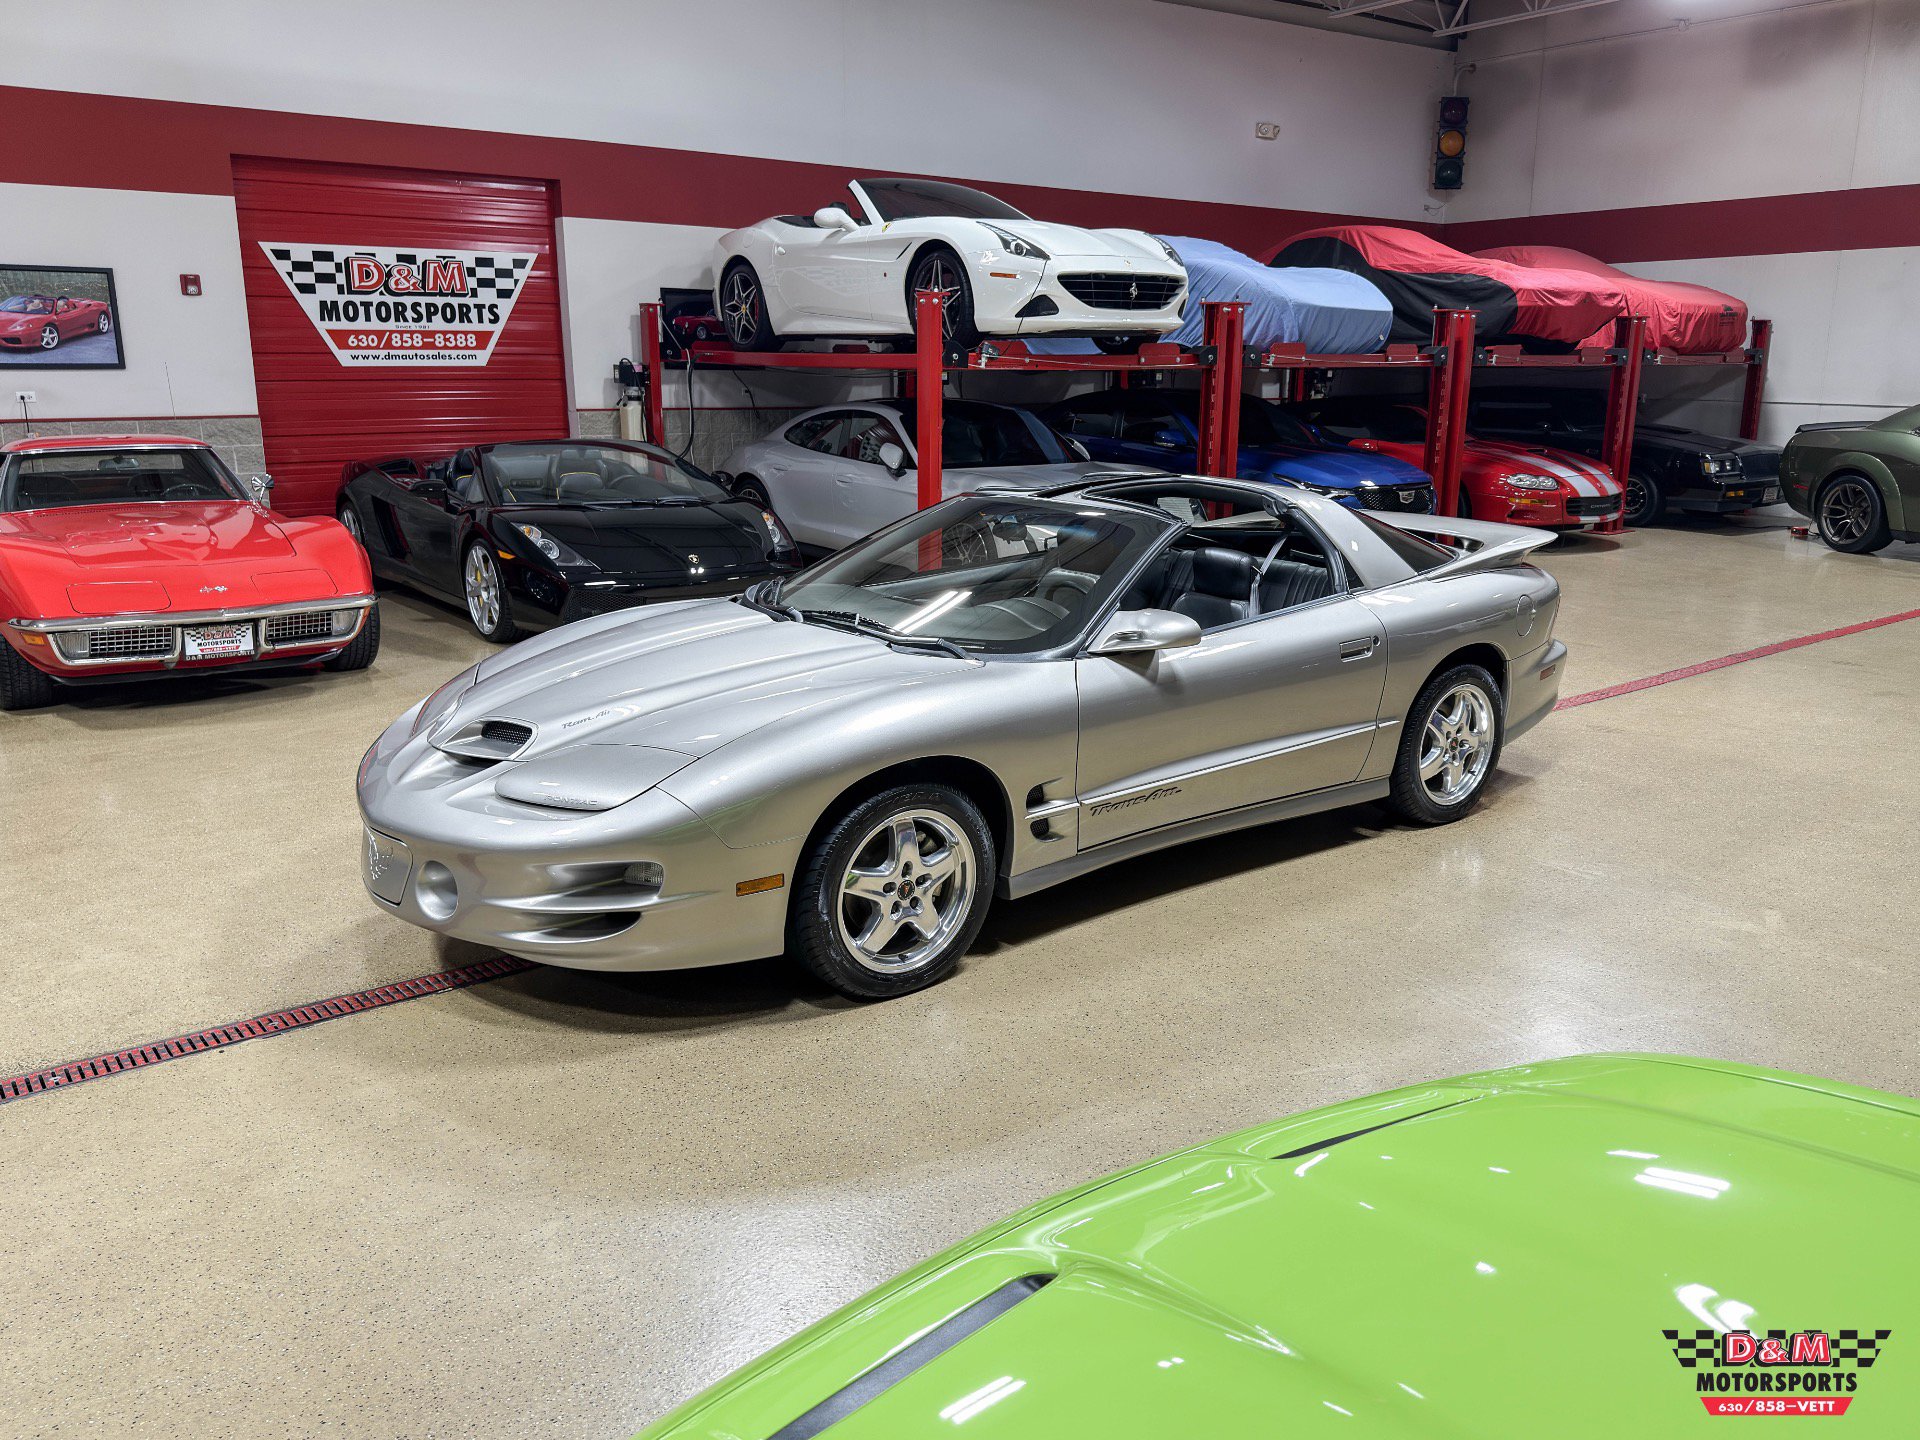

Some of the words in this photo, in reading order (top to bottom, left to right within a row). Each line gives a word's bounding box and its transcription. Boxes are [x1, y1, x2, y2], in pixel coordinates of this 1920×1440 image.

[345, 257, 470, 298] D&M
[319, 300, 500, 325] MOTORSPORTS
[350, 351, 478, 361] www.dmautosales.com
[197, 638, 242, 648] MOTORSPORTS
[204, 649, 255, 659] MOTORSPORTS
